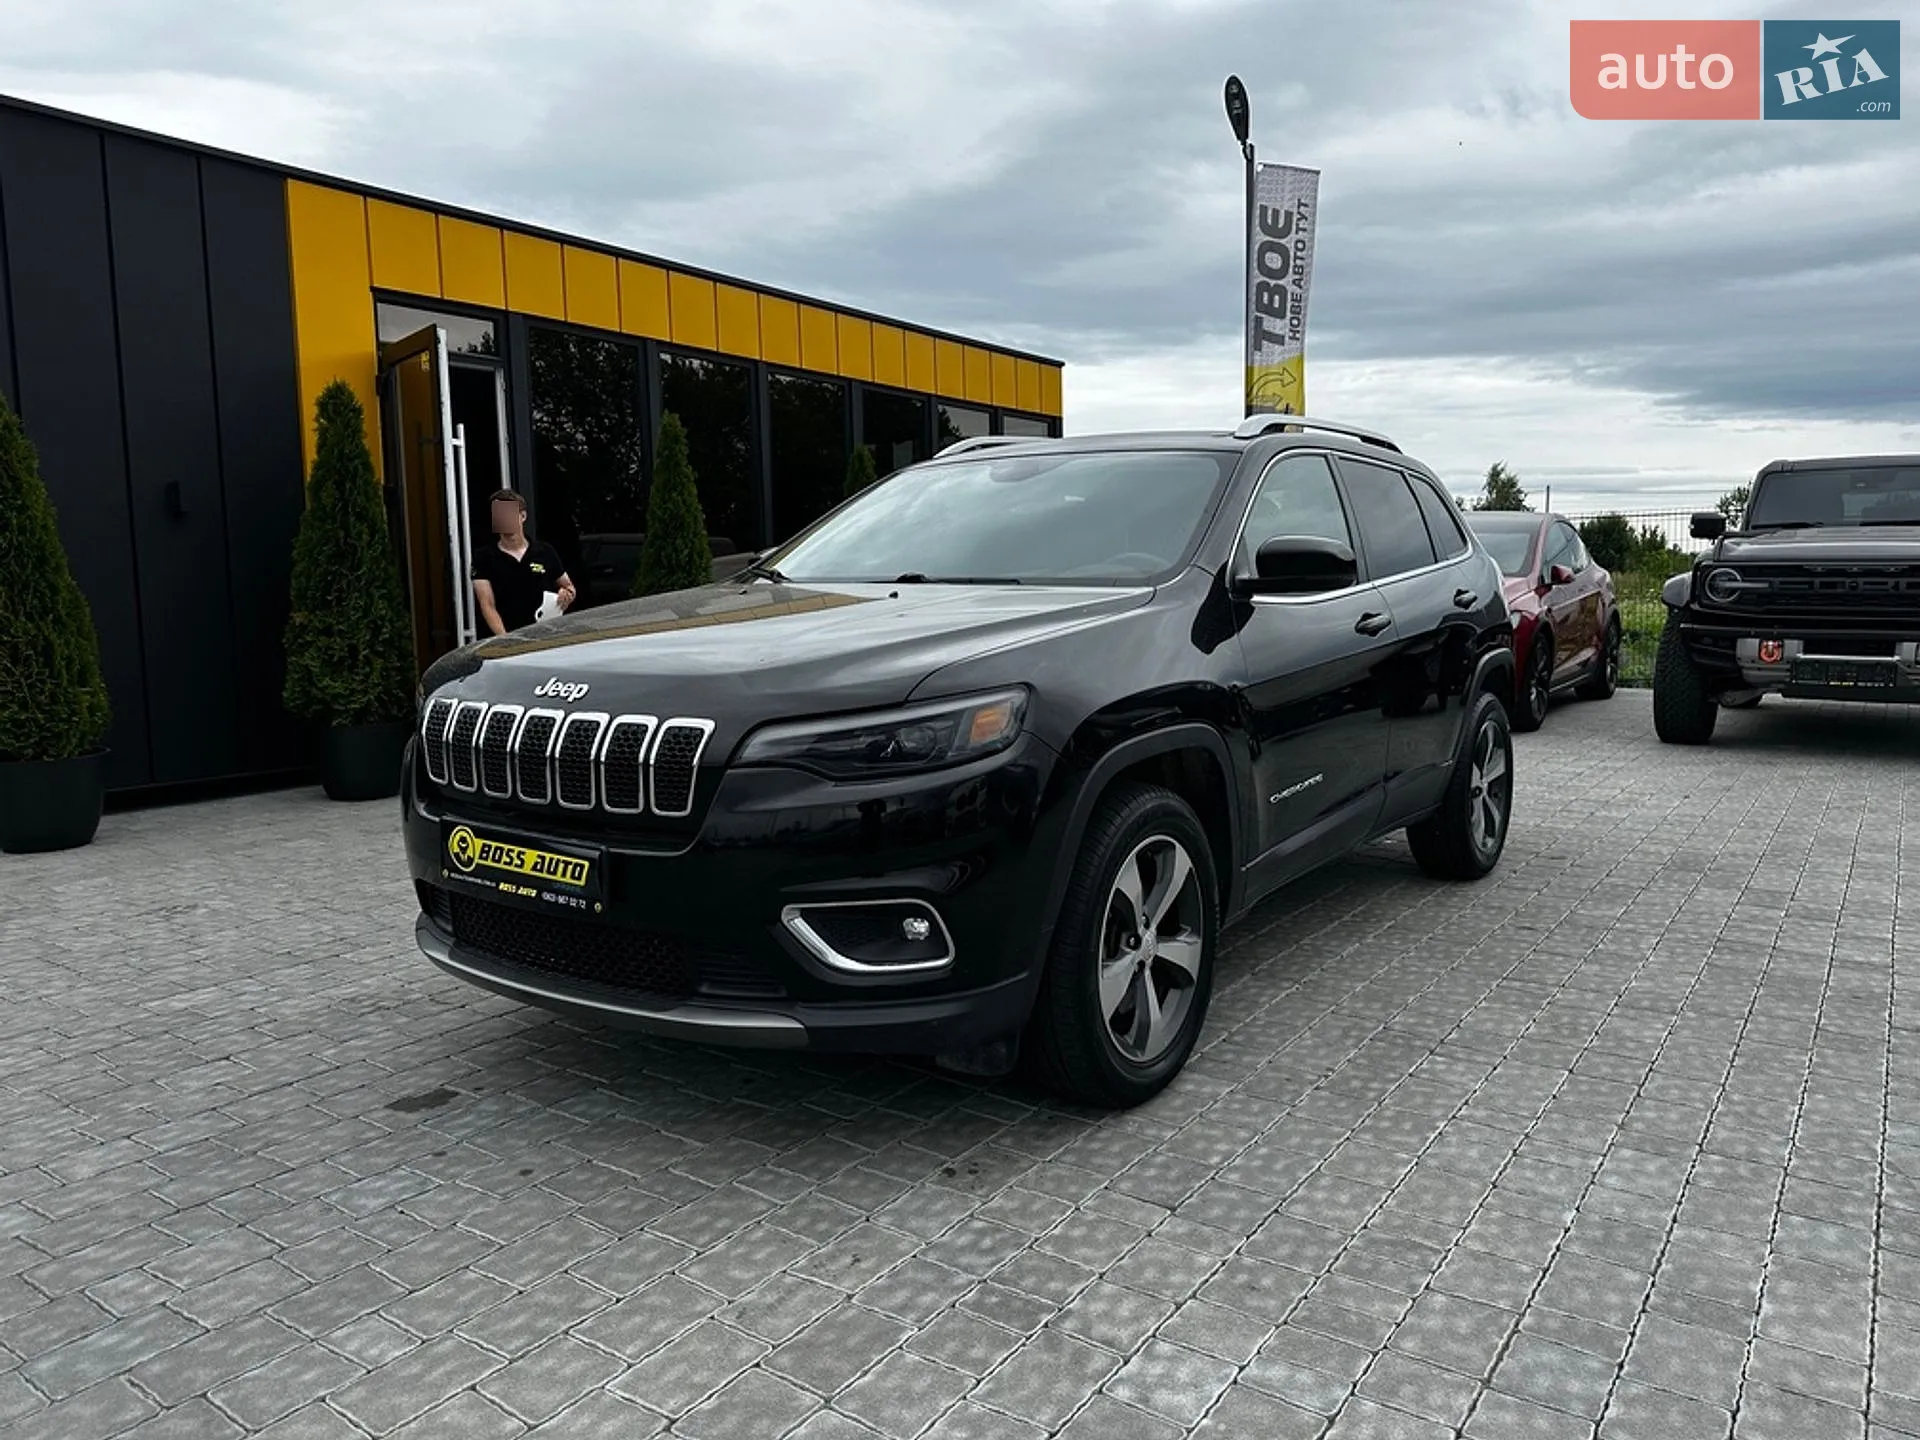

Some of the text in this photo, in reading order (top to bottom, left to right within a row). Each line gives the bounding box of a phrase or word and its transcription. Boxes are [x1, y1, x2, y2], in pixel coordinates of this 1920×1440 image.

[1288, 198, 1309, 341] НОВЕ АВТО ТУТ
[534, 676, 590, 702] Jeep
[478, 843, 527, 869] BOSS
